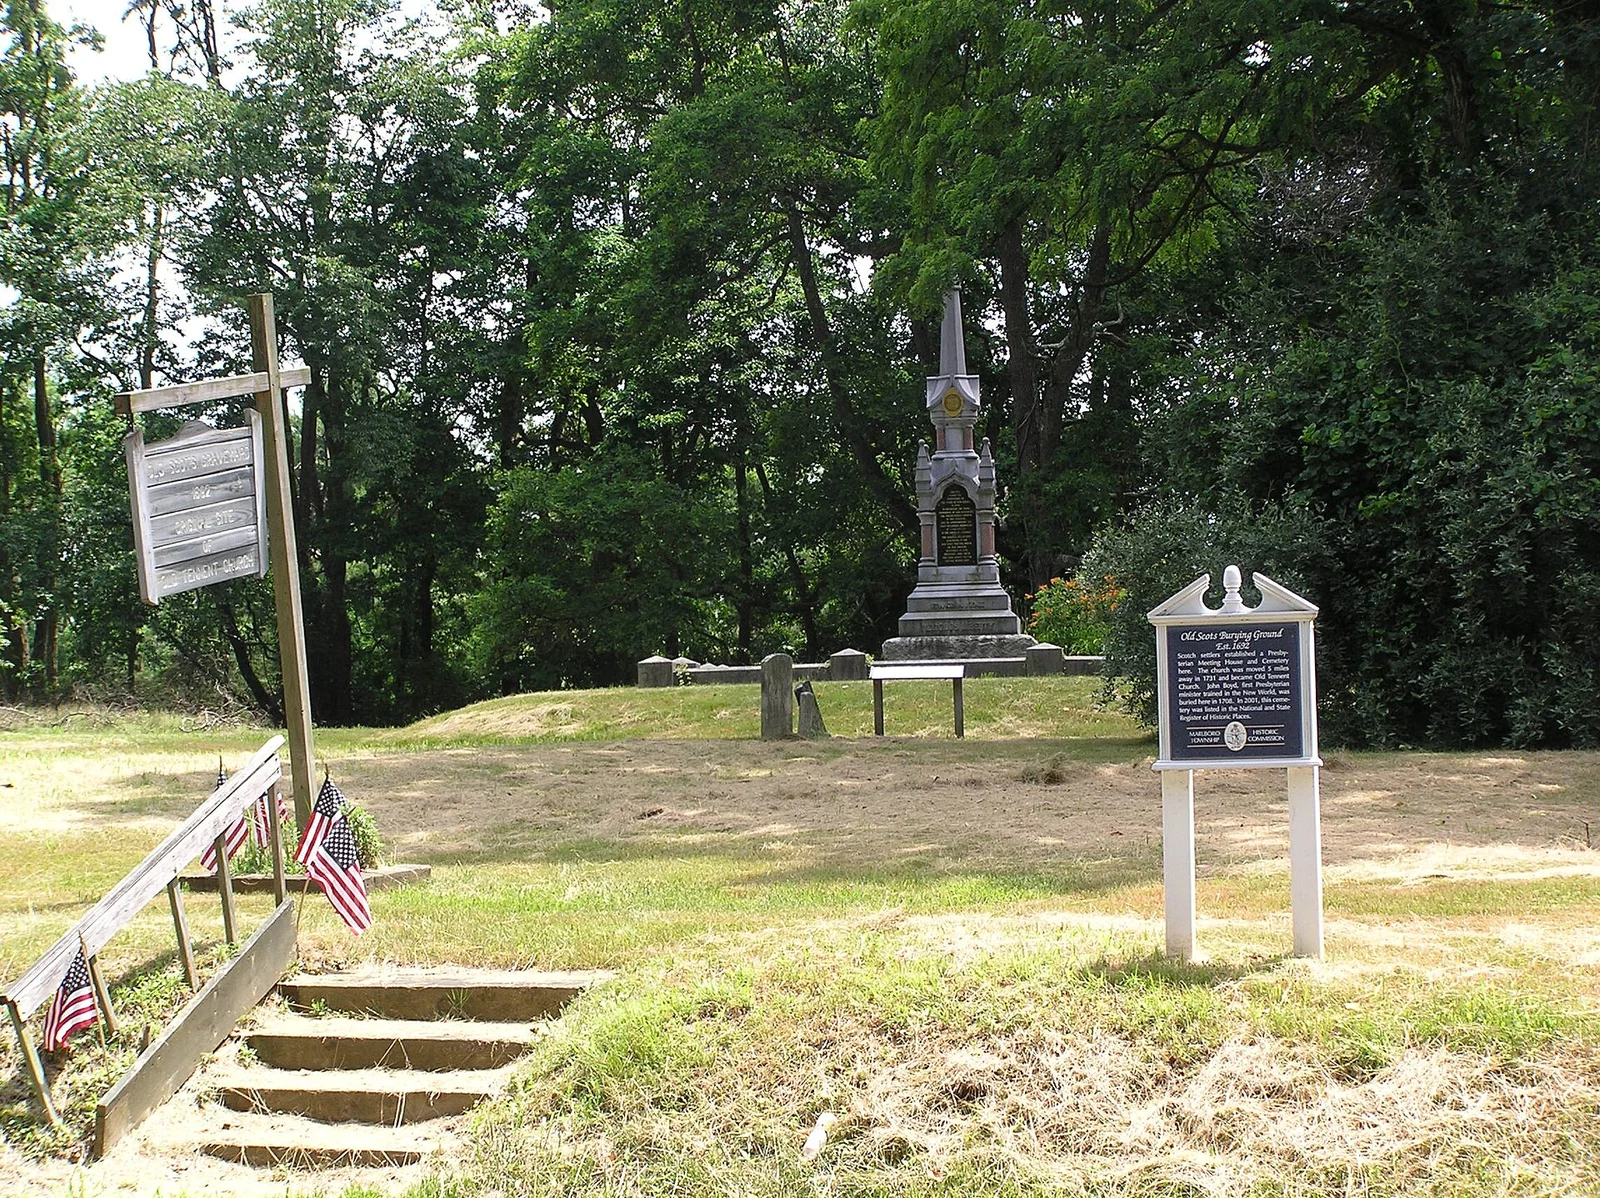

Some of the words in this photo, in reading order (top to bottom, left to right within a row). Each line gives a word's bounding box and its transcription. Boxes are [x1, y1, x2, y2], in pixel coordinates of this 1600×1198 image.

[216, 509, 234, 525] SITE
[202, 540, 212, 554] OF
[182, 562, 219, 583] TENNENT
[223, 552, 255, 573] CHURCH
[1180, 631, 1196, 641] Old
[1196, 631, 1218, 641] Scots
[1219, 630, 1252, 642] Burying
[1253, 628, 1284, 641] Ground
[1216, 643, 1231, 651] Est.
[1198, 659, 1221, 667] Meeting
[1179, 698, 1197, 706] buried
[1204, 705, 1220, 713] listed
